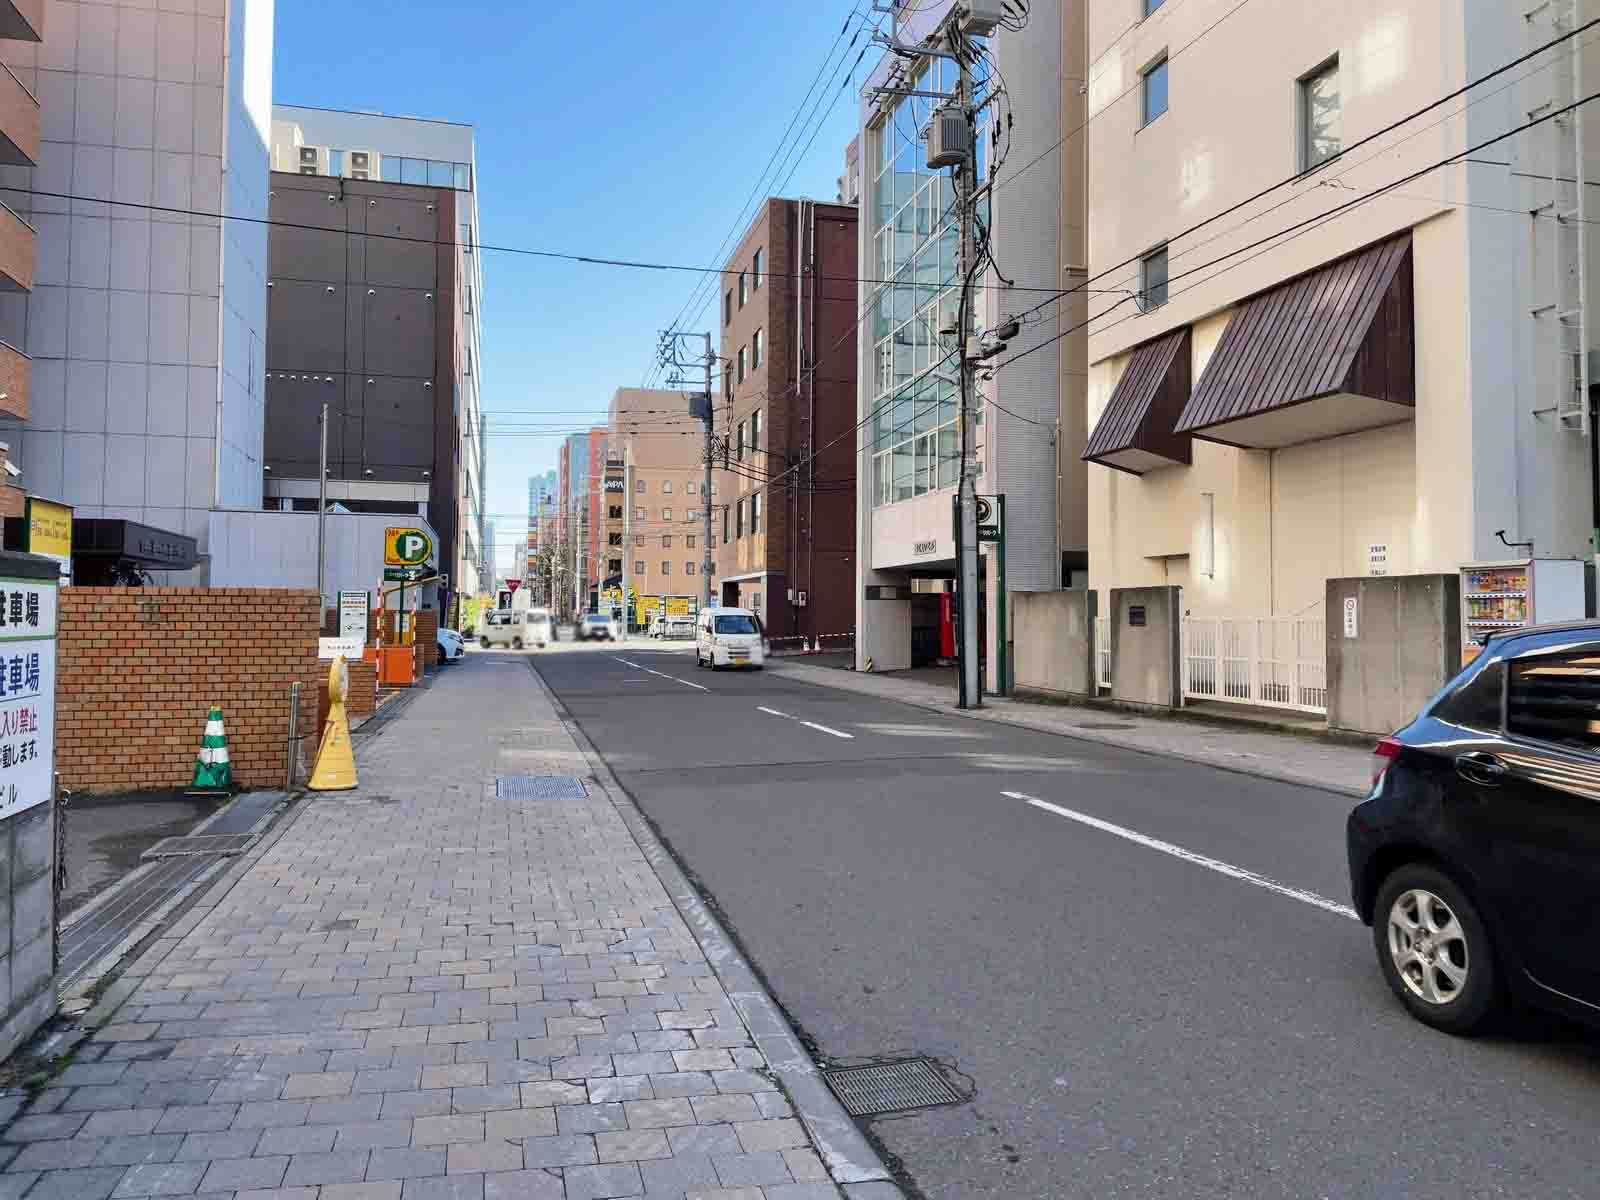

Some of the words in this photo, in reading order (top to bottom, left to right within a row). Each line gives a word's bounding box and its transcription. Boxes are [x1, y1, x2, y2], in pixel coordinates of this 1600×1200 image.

[405, 535, 424, 558] P
[0, 740, 38, 768] 動します。
